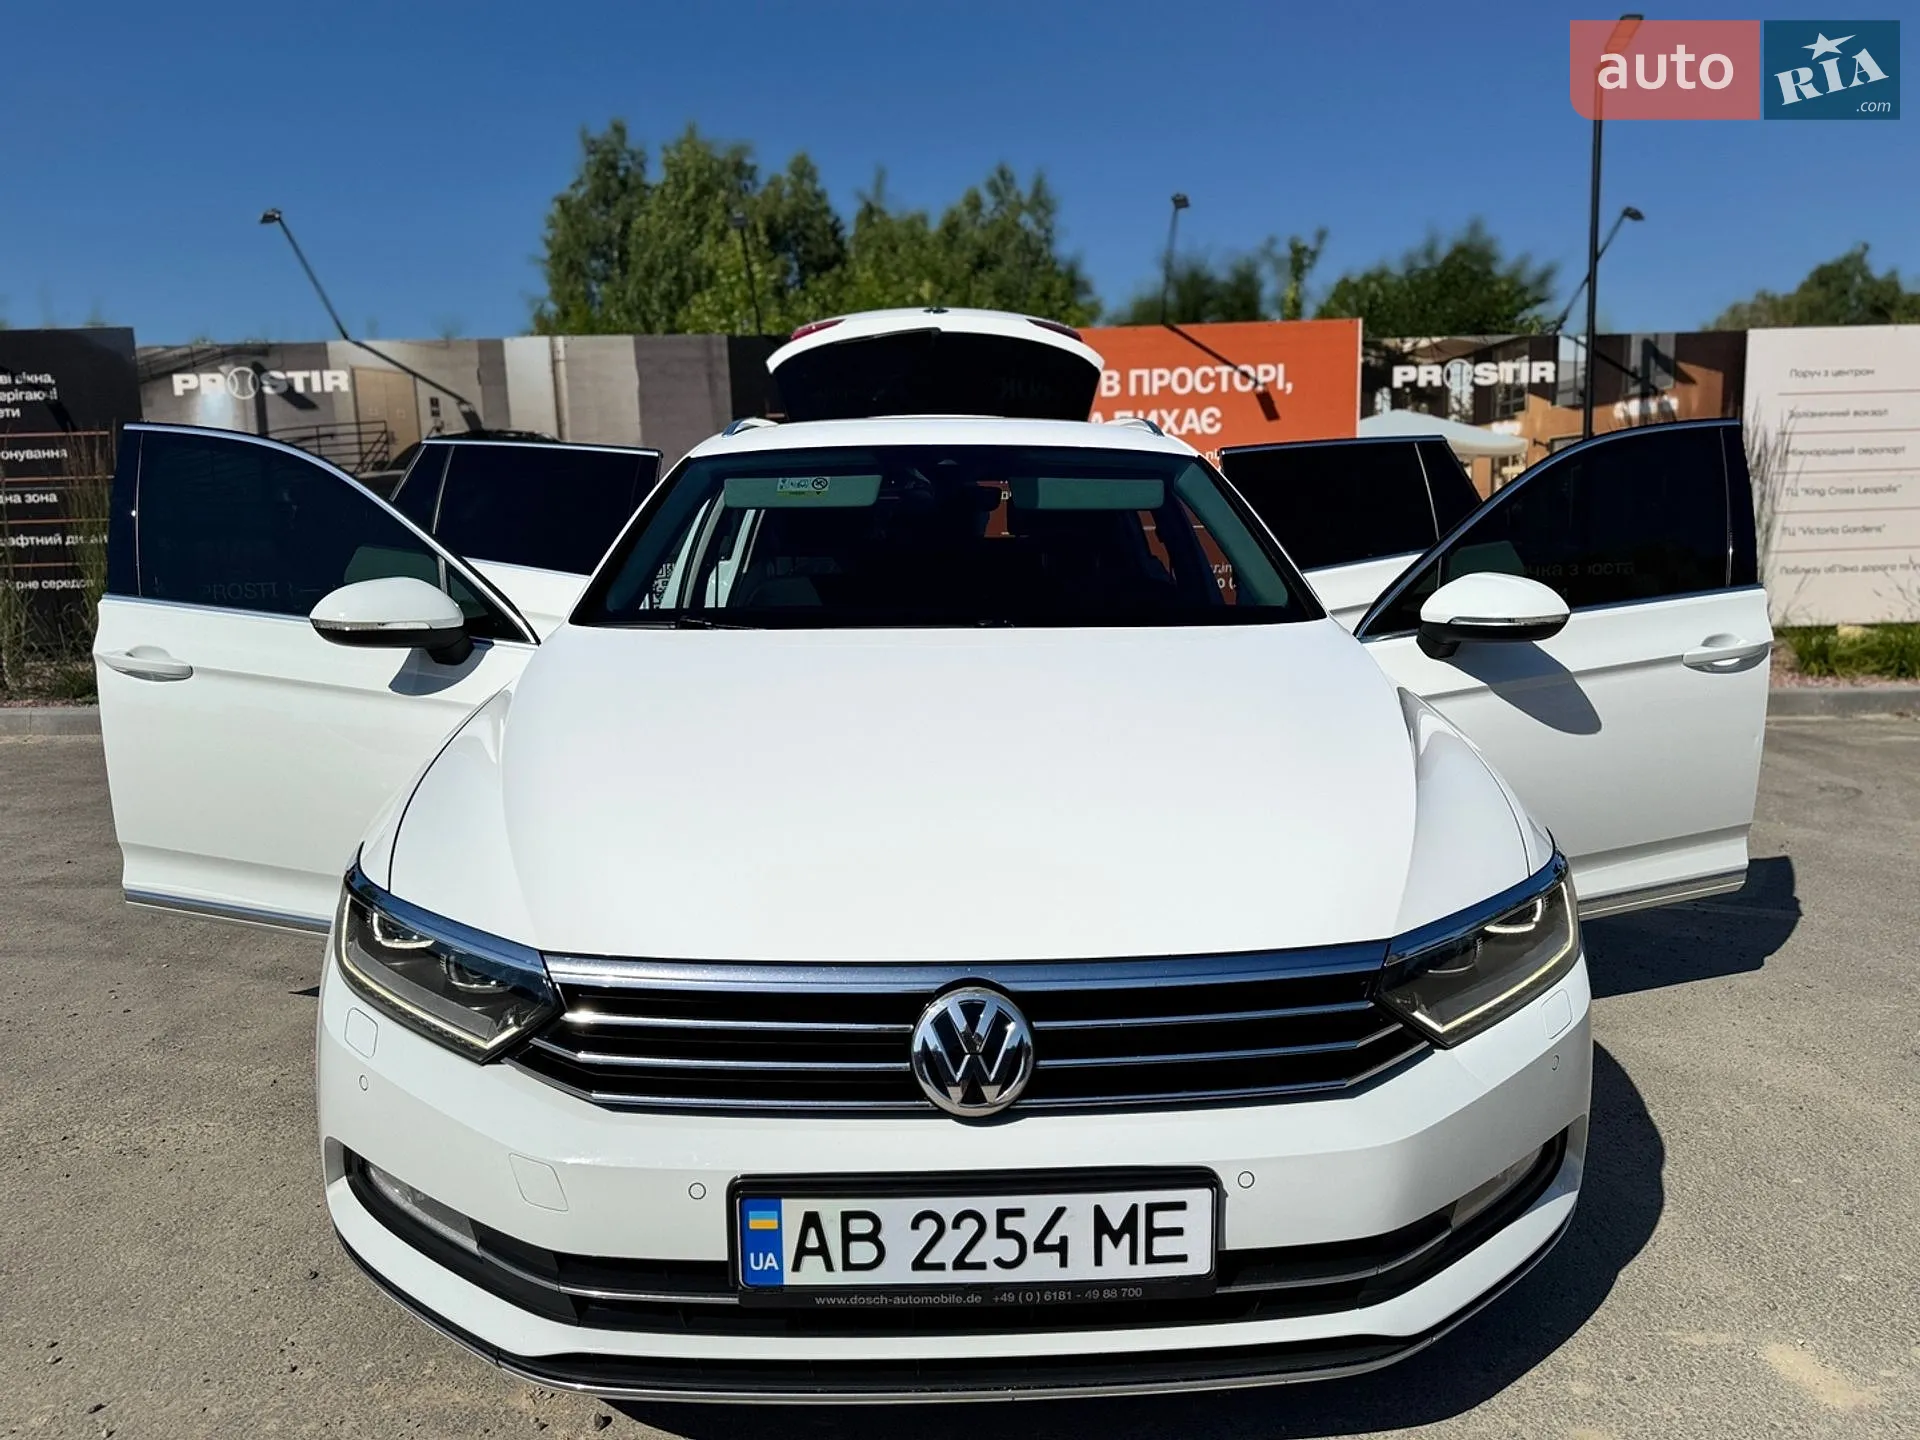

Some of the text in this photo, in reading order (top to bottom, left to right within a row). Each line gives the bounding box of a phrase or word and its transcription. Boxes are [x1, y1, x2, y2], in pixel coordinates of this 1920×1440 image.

[1128, 363, 1293, 396] ПРОСТОРІ,
[1392, 359, 1556, 390] PROSTIR
[24, 493, 58, 504] зона
[791, 1201, 1188, 1273] AB 2254 ME
[749, 1251, 779, 1271] UA
[814, 1292, 982, 1305] www.dosch-automobile.de
[992, 1291, 1015, 1303] +49
[1044, 1290, 1073, 1302] 6181
[1085, 1288, 1100, 1300] 49
[1121, 1286, 1143, 1298] 700
